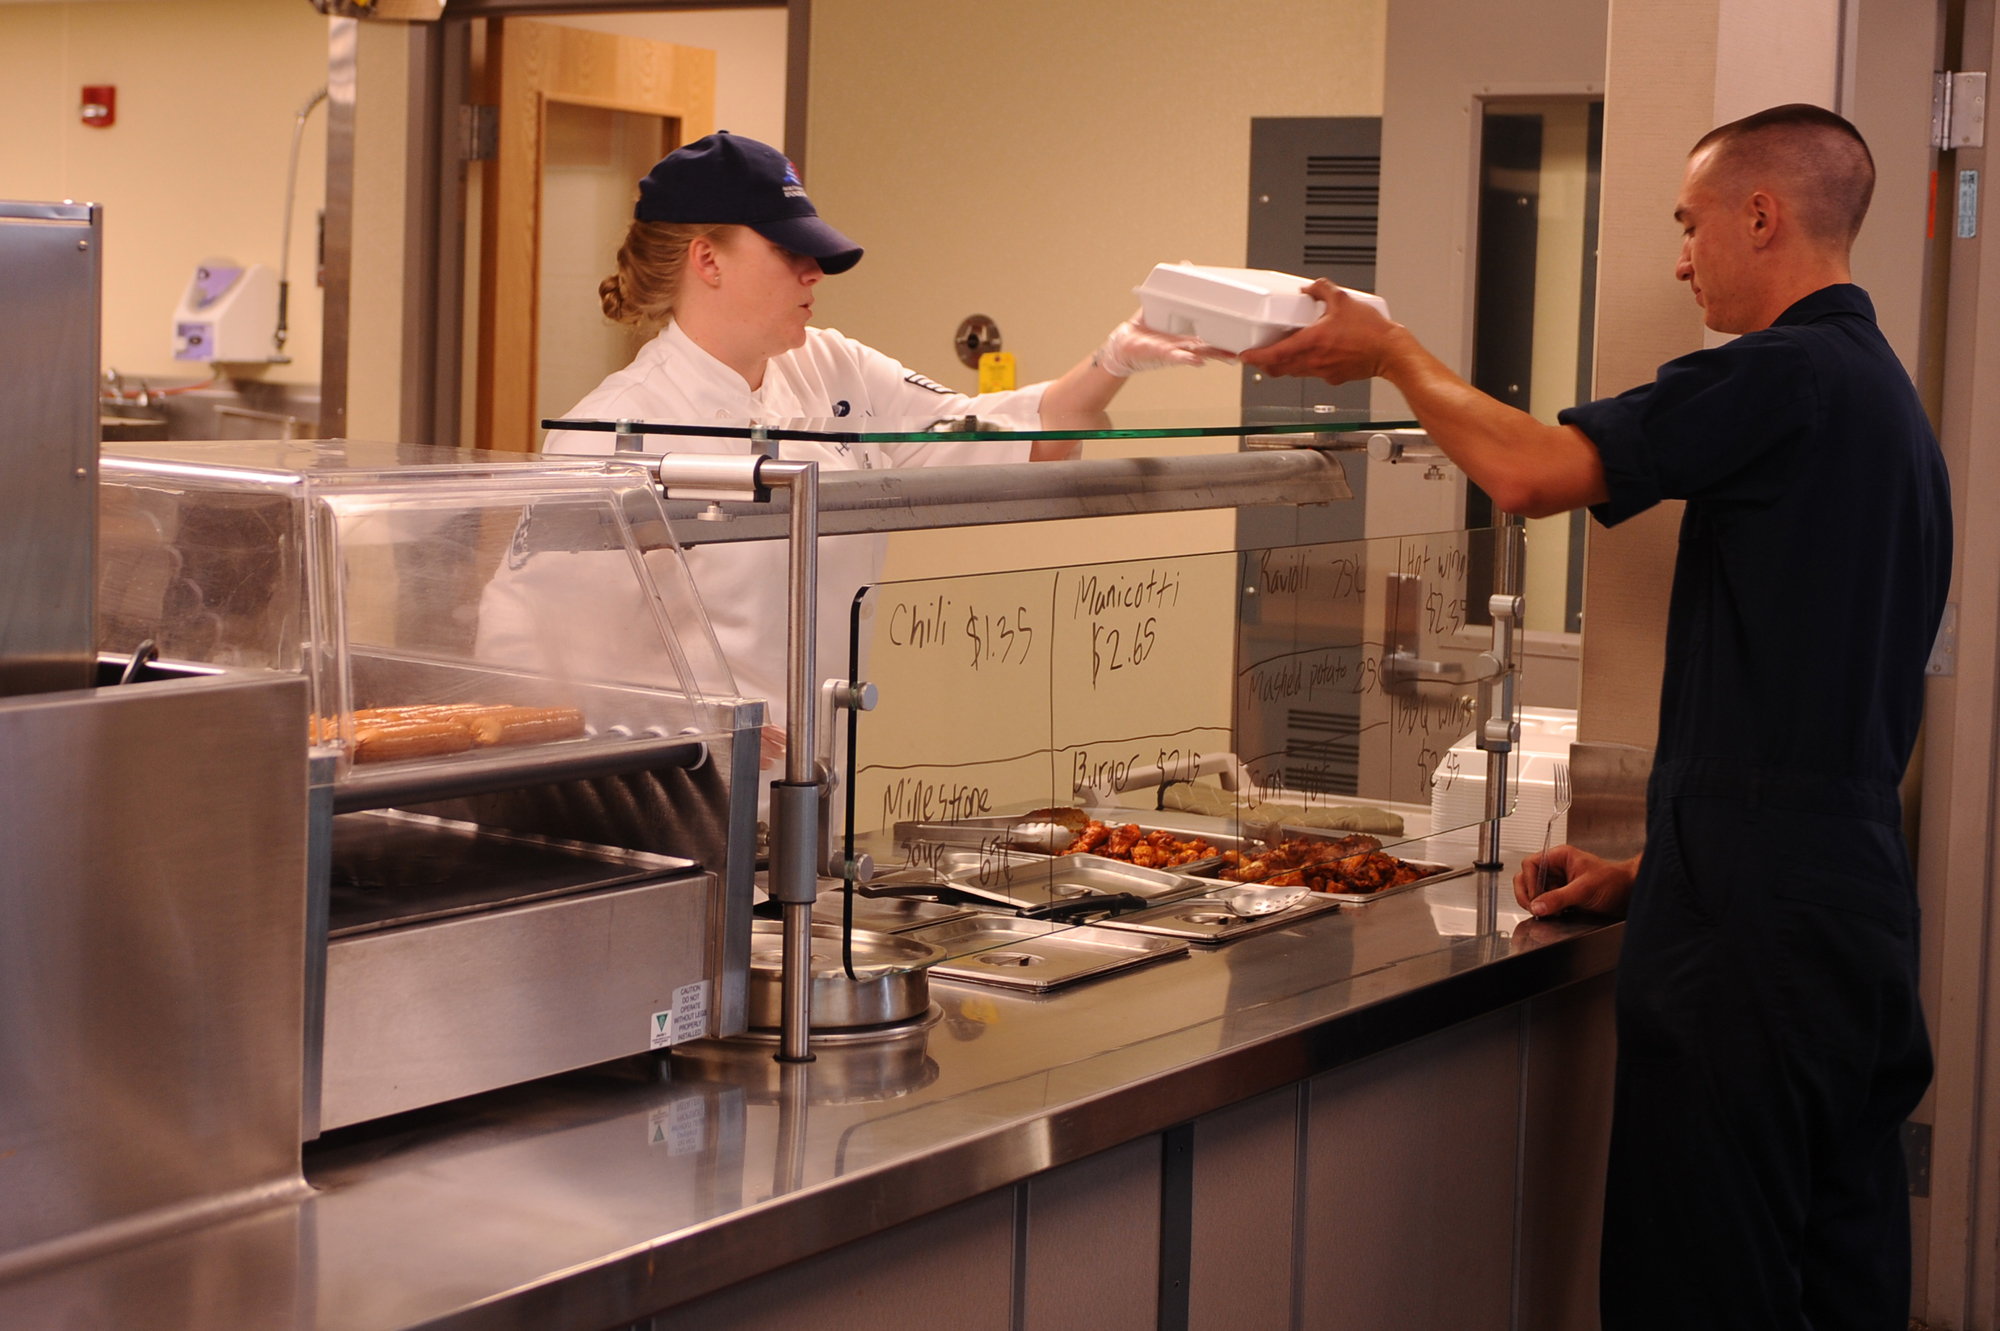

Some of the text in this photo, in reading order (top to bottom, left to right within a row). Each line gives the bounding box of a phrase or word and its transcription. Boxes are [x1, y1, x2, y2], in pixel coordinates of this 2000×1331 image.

[1258, 548, 1312, 596] Ravioli
[1407, 543, 1431, 579] Hot
[1074, 568, 1180, 620] Manicotti
[889, 594, 1033, 671] Chili $1.35
[1092, 617, 1157, 691] $2.65
[1247, 661, 1303, 712] Mashed
[1308, 653, 1348, 702] potato
[1072, 750, 1140, 801] Burger
[1247, 768, 1282, 811] Corn
[681, 1002, 700, 1013] OPERATE
[682, 996, 689, 1004] DO
